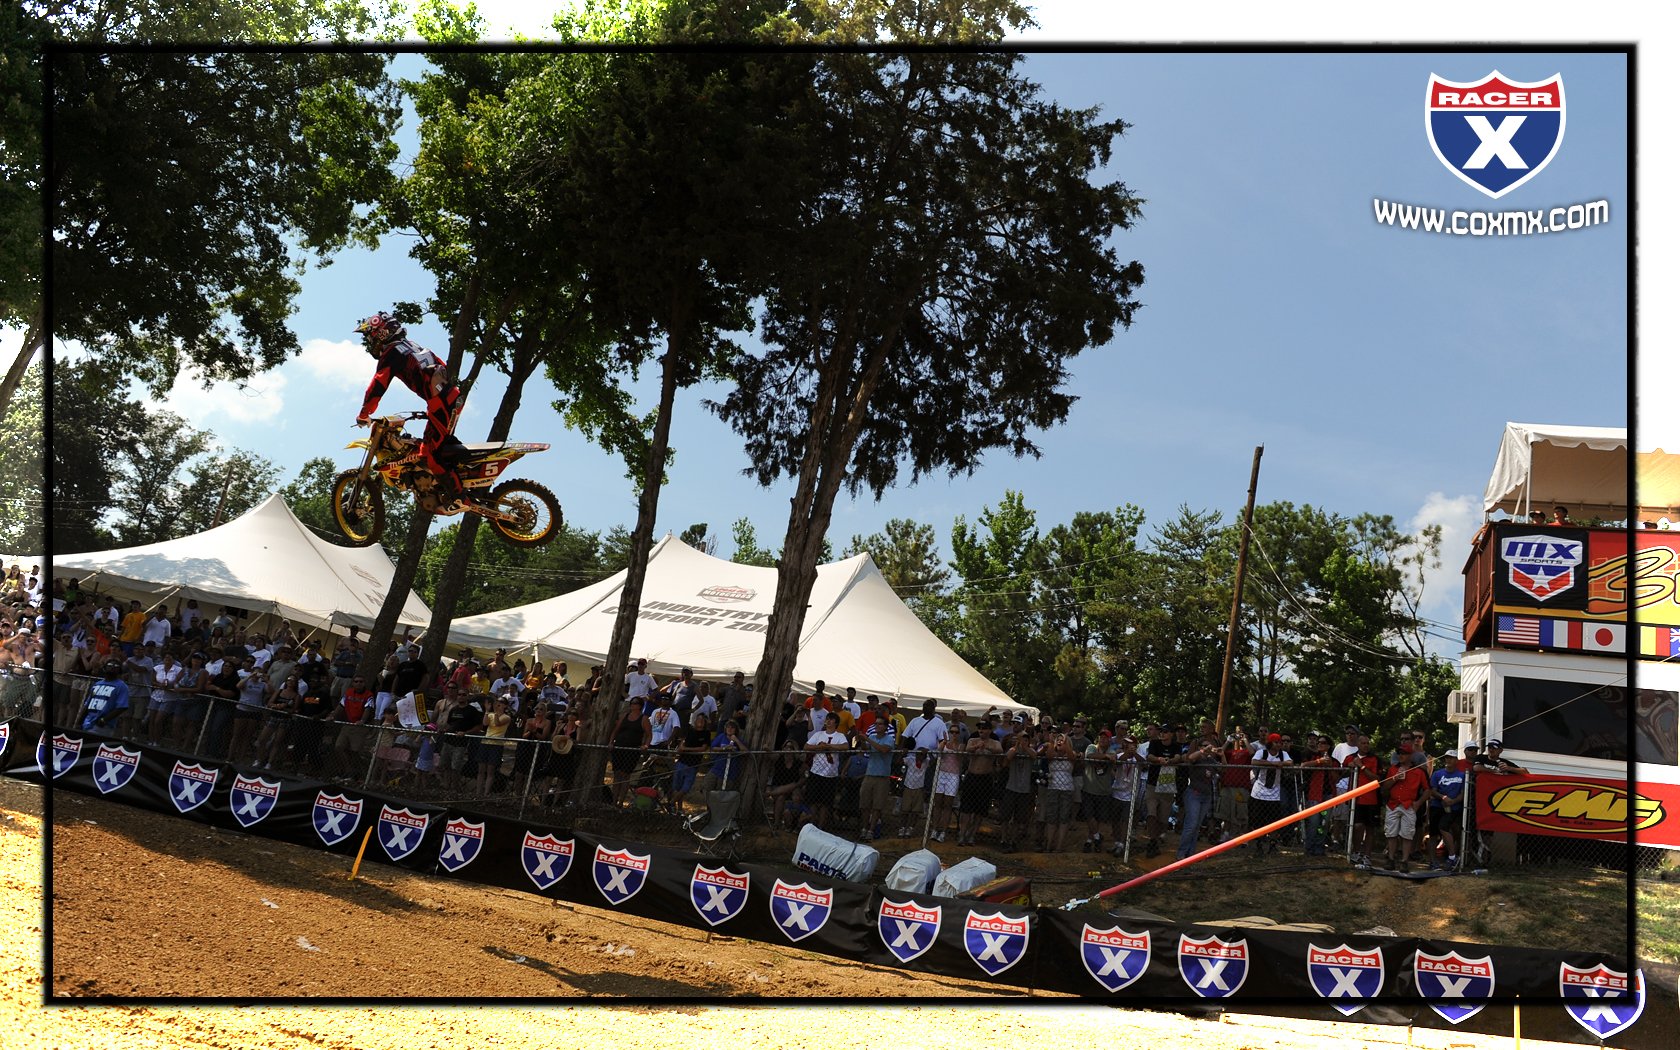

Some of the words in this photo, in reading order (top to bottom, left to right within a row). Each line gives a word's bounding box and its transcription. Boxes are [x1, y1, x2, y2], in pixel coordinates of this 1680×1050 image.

[485, 462, 499, 476] 5
[601, 606, 723, 626] CMFORT
[642, 600, 769, 621] INDUSTRY
[100, 751, 136, 764] RACER
[98, 761, 125, 785] X
[176, 767, 214, 782] RACER
[177, 779, 201, 803] X
[237, 780, 276, 796] RACER
[238, 794, 262, 818] X
[318, 797, 358, 813] RACER
[319, 810, 344, 835] X
[384, 811, 424, 827] RACER
[386, 825, 411, 850] X
[447, 825, 480, 837] ACER
[441, 835, 469, 861] X
[527, 838, 570, 853] RACER
[532, 851, 558, 879] X
[599, 852, 646, 869] RACER
[606, 866, 632, 895] X
[697, 872, 746, 888] RACER
[702, 886, 732, 915] X
[775, 888, 827, 904] RACER
[783, 901, 814, 931] X
[884, 907, 935, 922] RACER
[891, 920, 922, 951] X
[970, 919, 1023, 934] RACER
[977, 932, 1009, 964] X
[1086, 933, 1144, 948] RACER
[1184, 944, 1242, 958] RACER
[1313, 954, 1376, 966] RACER
[1097, 947, 1131, 979] X
[1420, 961, 1487, 975] RACER
[1196, 959, 1229, 991] X
[1328, 967, 1362, 997] X
[1435, 975, 1473, 1010] X
[1582, 988, 1622, 1024] X
